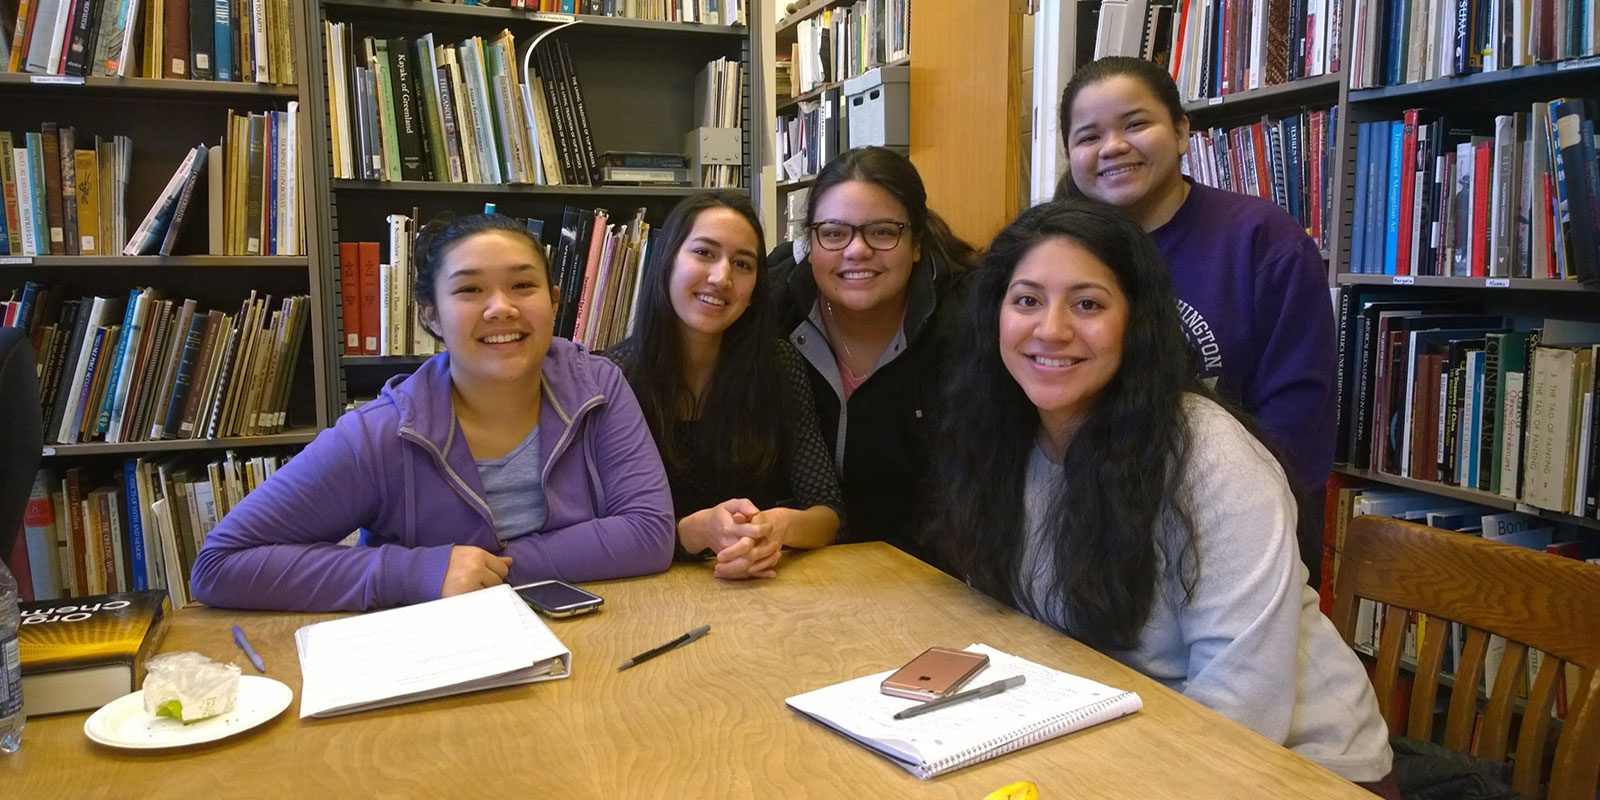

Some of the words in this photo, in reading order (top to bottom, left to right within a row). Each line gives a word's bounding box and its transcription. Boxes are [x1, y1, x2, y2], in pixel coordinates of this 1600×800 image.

[396, 54, 407, 81] Kayaks
[400, 82, 408, 91] of
[438, 76, 447, 91] THE
[469, 87, 477, 105] Alaska
[401, 93, 413, 133] Greenland
[440, 93, 452, 120] CANOE
[472, 106, 480, 126] Eskimo
[474, 127, 485, 153] Footwear
[549, 90, 557, 105] LIVING
[553, 106, 563, 130] TRADITION
[563, 152, 571, 168] MASKS
[560, 90, 568, 105] LIVING
[564, 107, 574, 130] TRADITION
[574, 152, 582, 168] MASKS
[573, 86, 581, 101] LIVING
[577, 102, 587, 127] TRADITION
[588, 151, 596, 167] MASKS
[1391, 132, 1401, 167] Treasures
[5, 182, 16, 197] Red
[1389, 178, 1399, 218] Mongolian
[6, 200, 20, 230] Thunder
[1340, 294, 1348, 328] CULTURAL
[1363, 318, 1371, 348] HISTORICAL
[1335, 354, 1344, 391] UNEARTHED
[1484, 341, 1498, 414] CHINESE
[1535, 382, 1543, 394] THE
[1507, 389, 1517, 417] Chinese
[1534, 399, 1542, 415] TAO
[1464, 422, 1470, 431] OF
[1481, 421, 1493, 452] ART
[1502, 418, 1514, 457] Symbolism
[1533, 420, 1540, 429] OF
[1547, 423, 1554, 432] OF
[1503, 458, 1511, 471] and
[1529, 434, 1539, 469] PAINTING
[1543, 437, 1553, 473] PAINTING
[70, 501, 81, 529] Families
[101, 521, 109, 532] THE
[131, 505, 140, 521] MYTH
[132, 523, 141, 535] AND
[133, 536, 143, 559] MEMORY
[21, 601, 131, 617] Chem
[22, 612, 92, 625] Org
